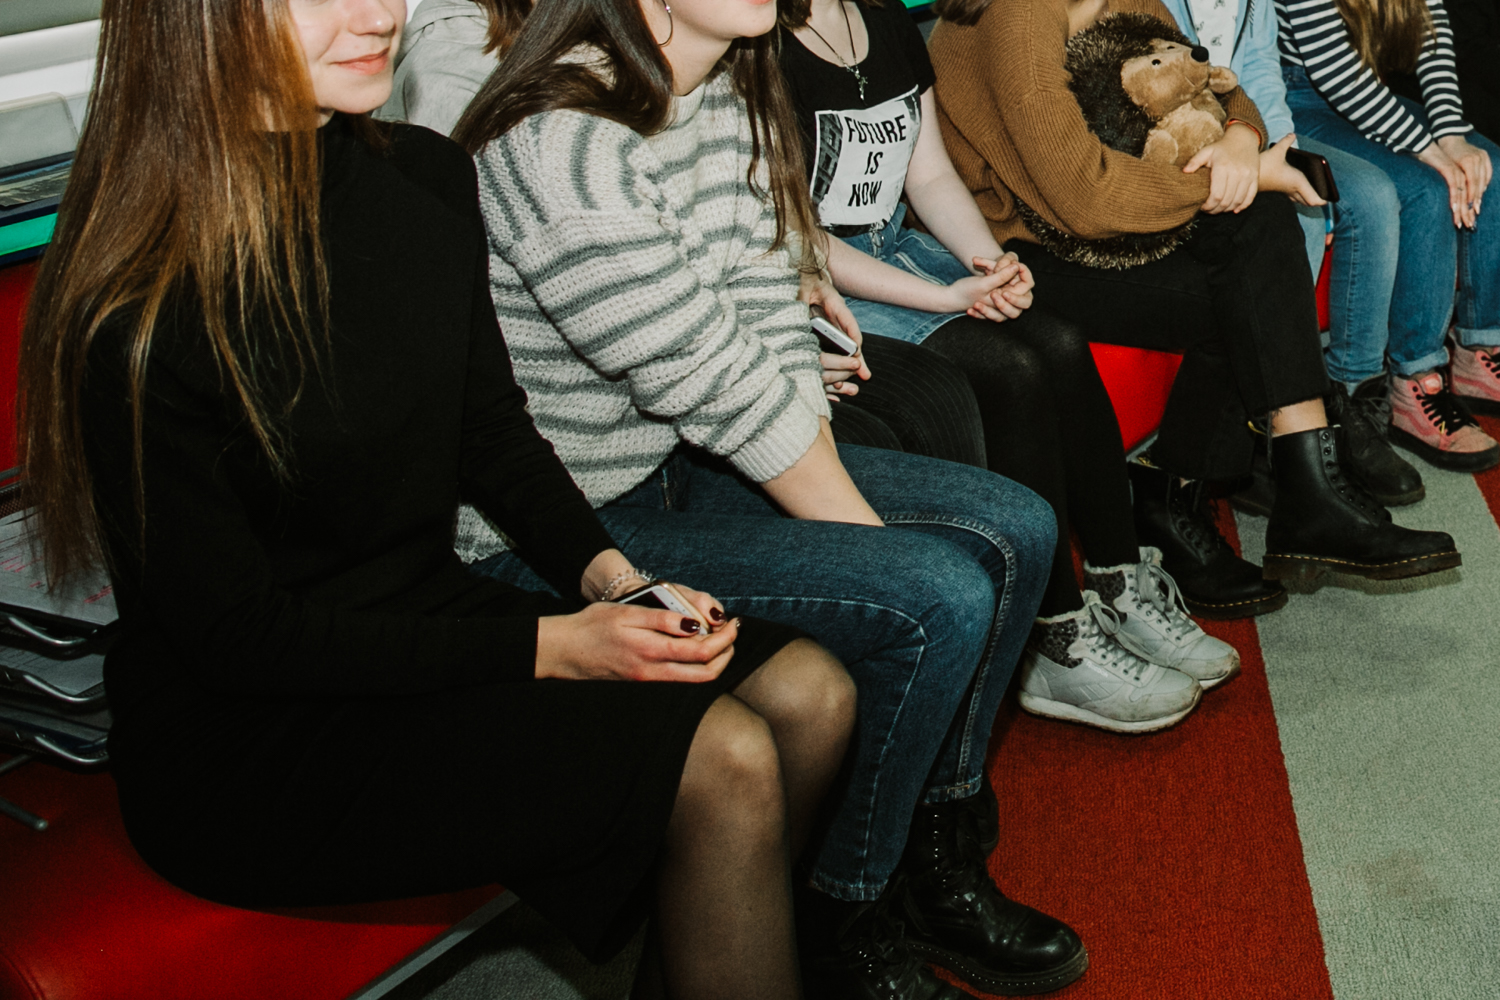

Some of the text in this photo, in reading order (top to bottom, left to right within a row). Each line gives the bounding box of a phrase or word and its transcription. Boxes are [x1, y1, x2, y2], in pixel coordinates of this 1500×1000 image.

[844, 114, 907, 144] FUTURE
[864, 151, 884, 175] IS
[847, 180, 882, 207] NOW
